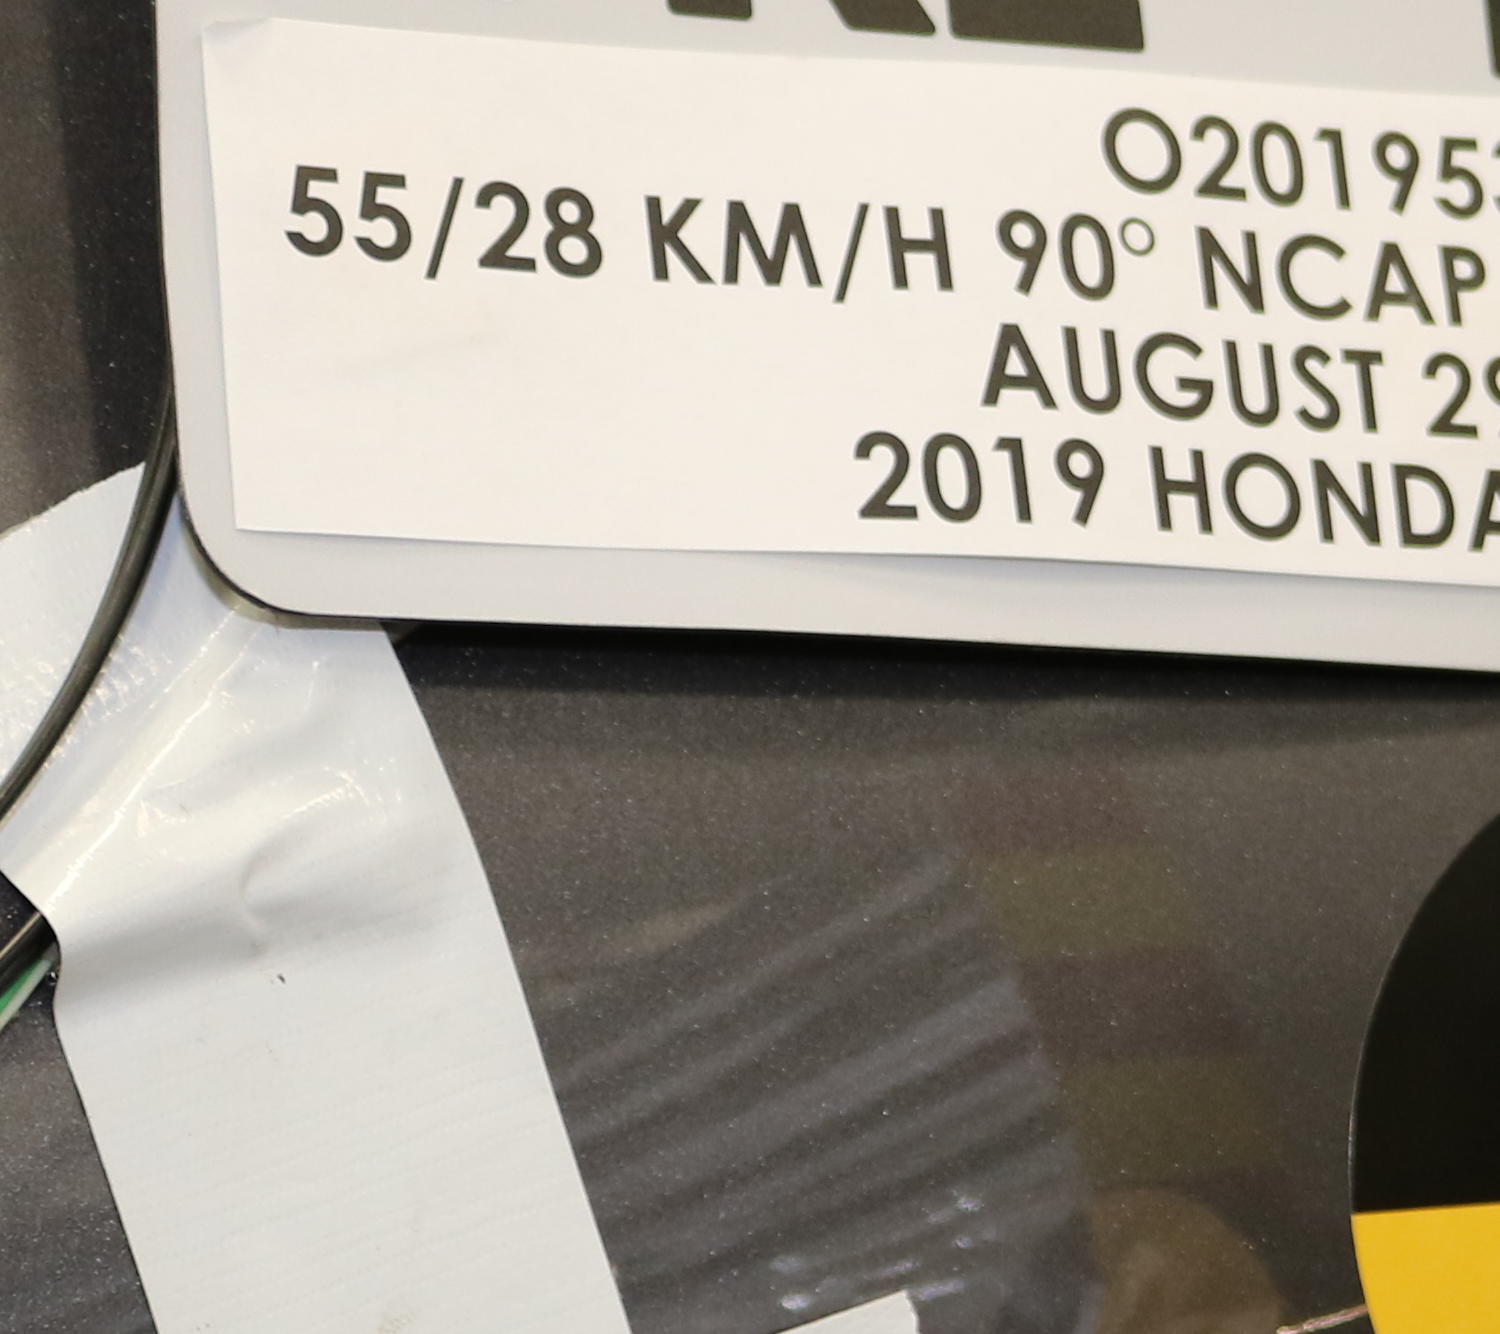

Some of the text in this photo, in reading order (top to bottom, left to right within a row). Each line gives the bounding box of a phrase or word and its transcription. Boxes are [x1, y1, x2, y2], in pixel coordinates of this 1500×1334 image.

[284, 163, 605, 281] 55/28
[644, 194, 955, 304] KM/H
[998, 208, 1156, 301] 90°
[1197, 224, 1488, 326] NCAP
[982, 322, 1385, 433] AUGUST
[854, 430, 1106, 526] 2019
